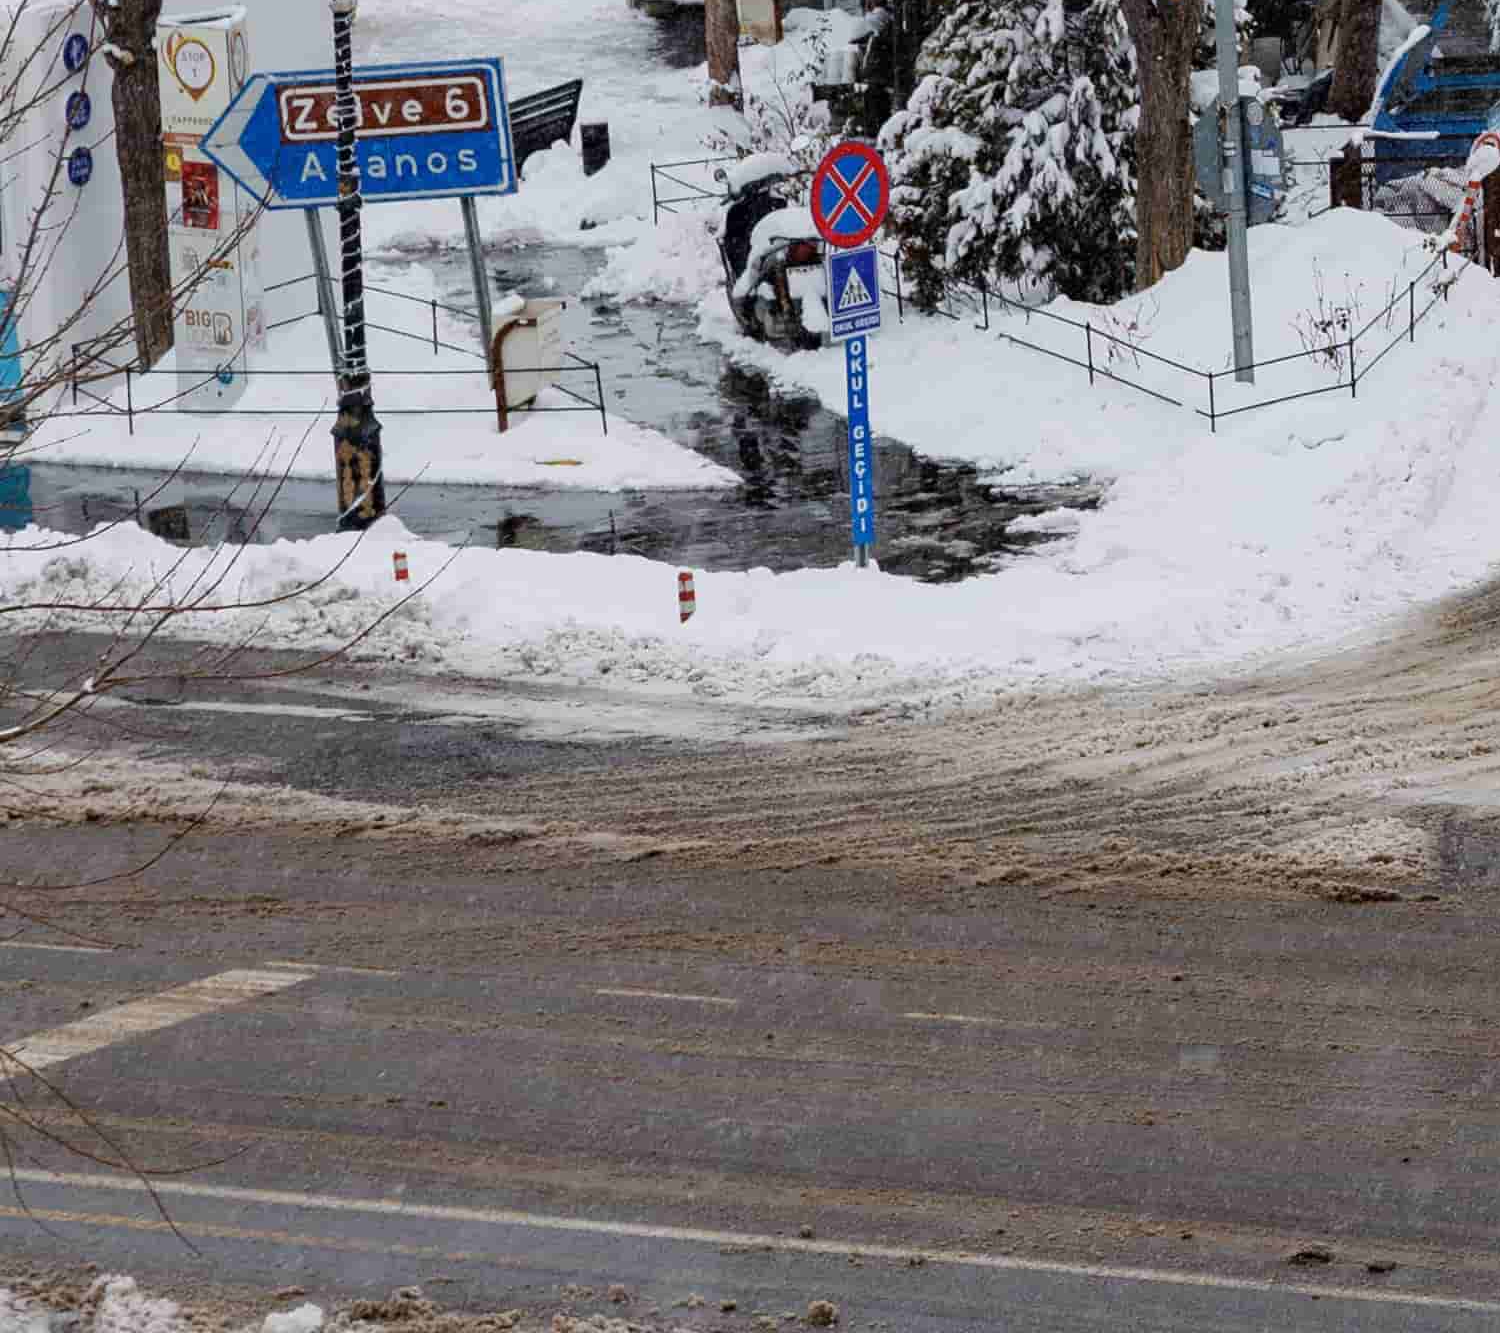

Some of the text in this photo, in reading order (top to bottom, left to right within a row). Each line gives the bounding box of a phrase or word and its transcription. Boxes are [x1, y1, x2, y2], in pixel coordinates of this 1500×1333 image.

[445, 86, 469, 119] 6
[301, 149, 478, 182] Aanos
[184, 309, 211, 327] BIG
[850, 341, 864, 408] OKUL
